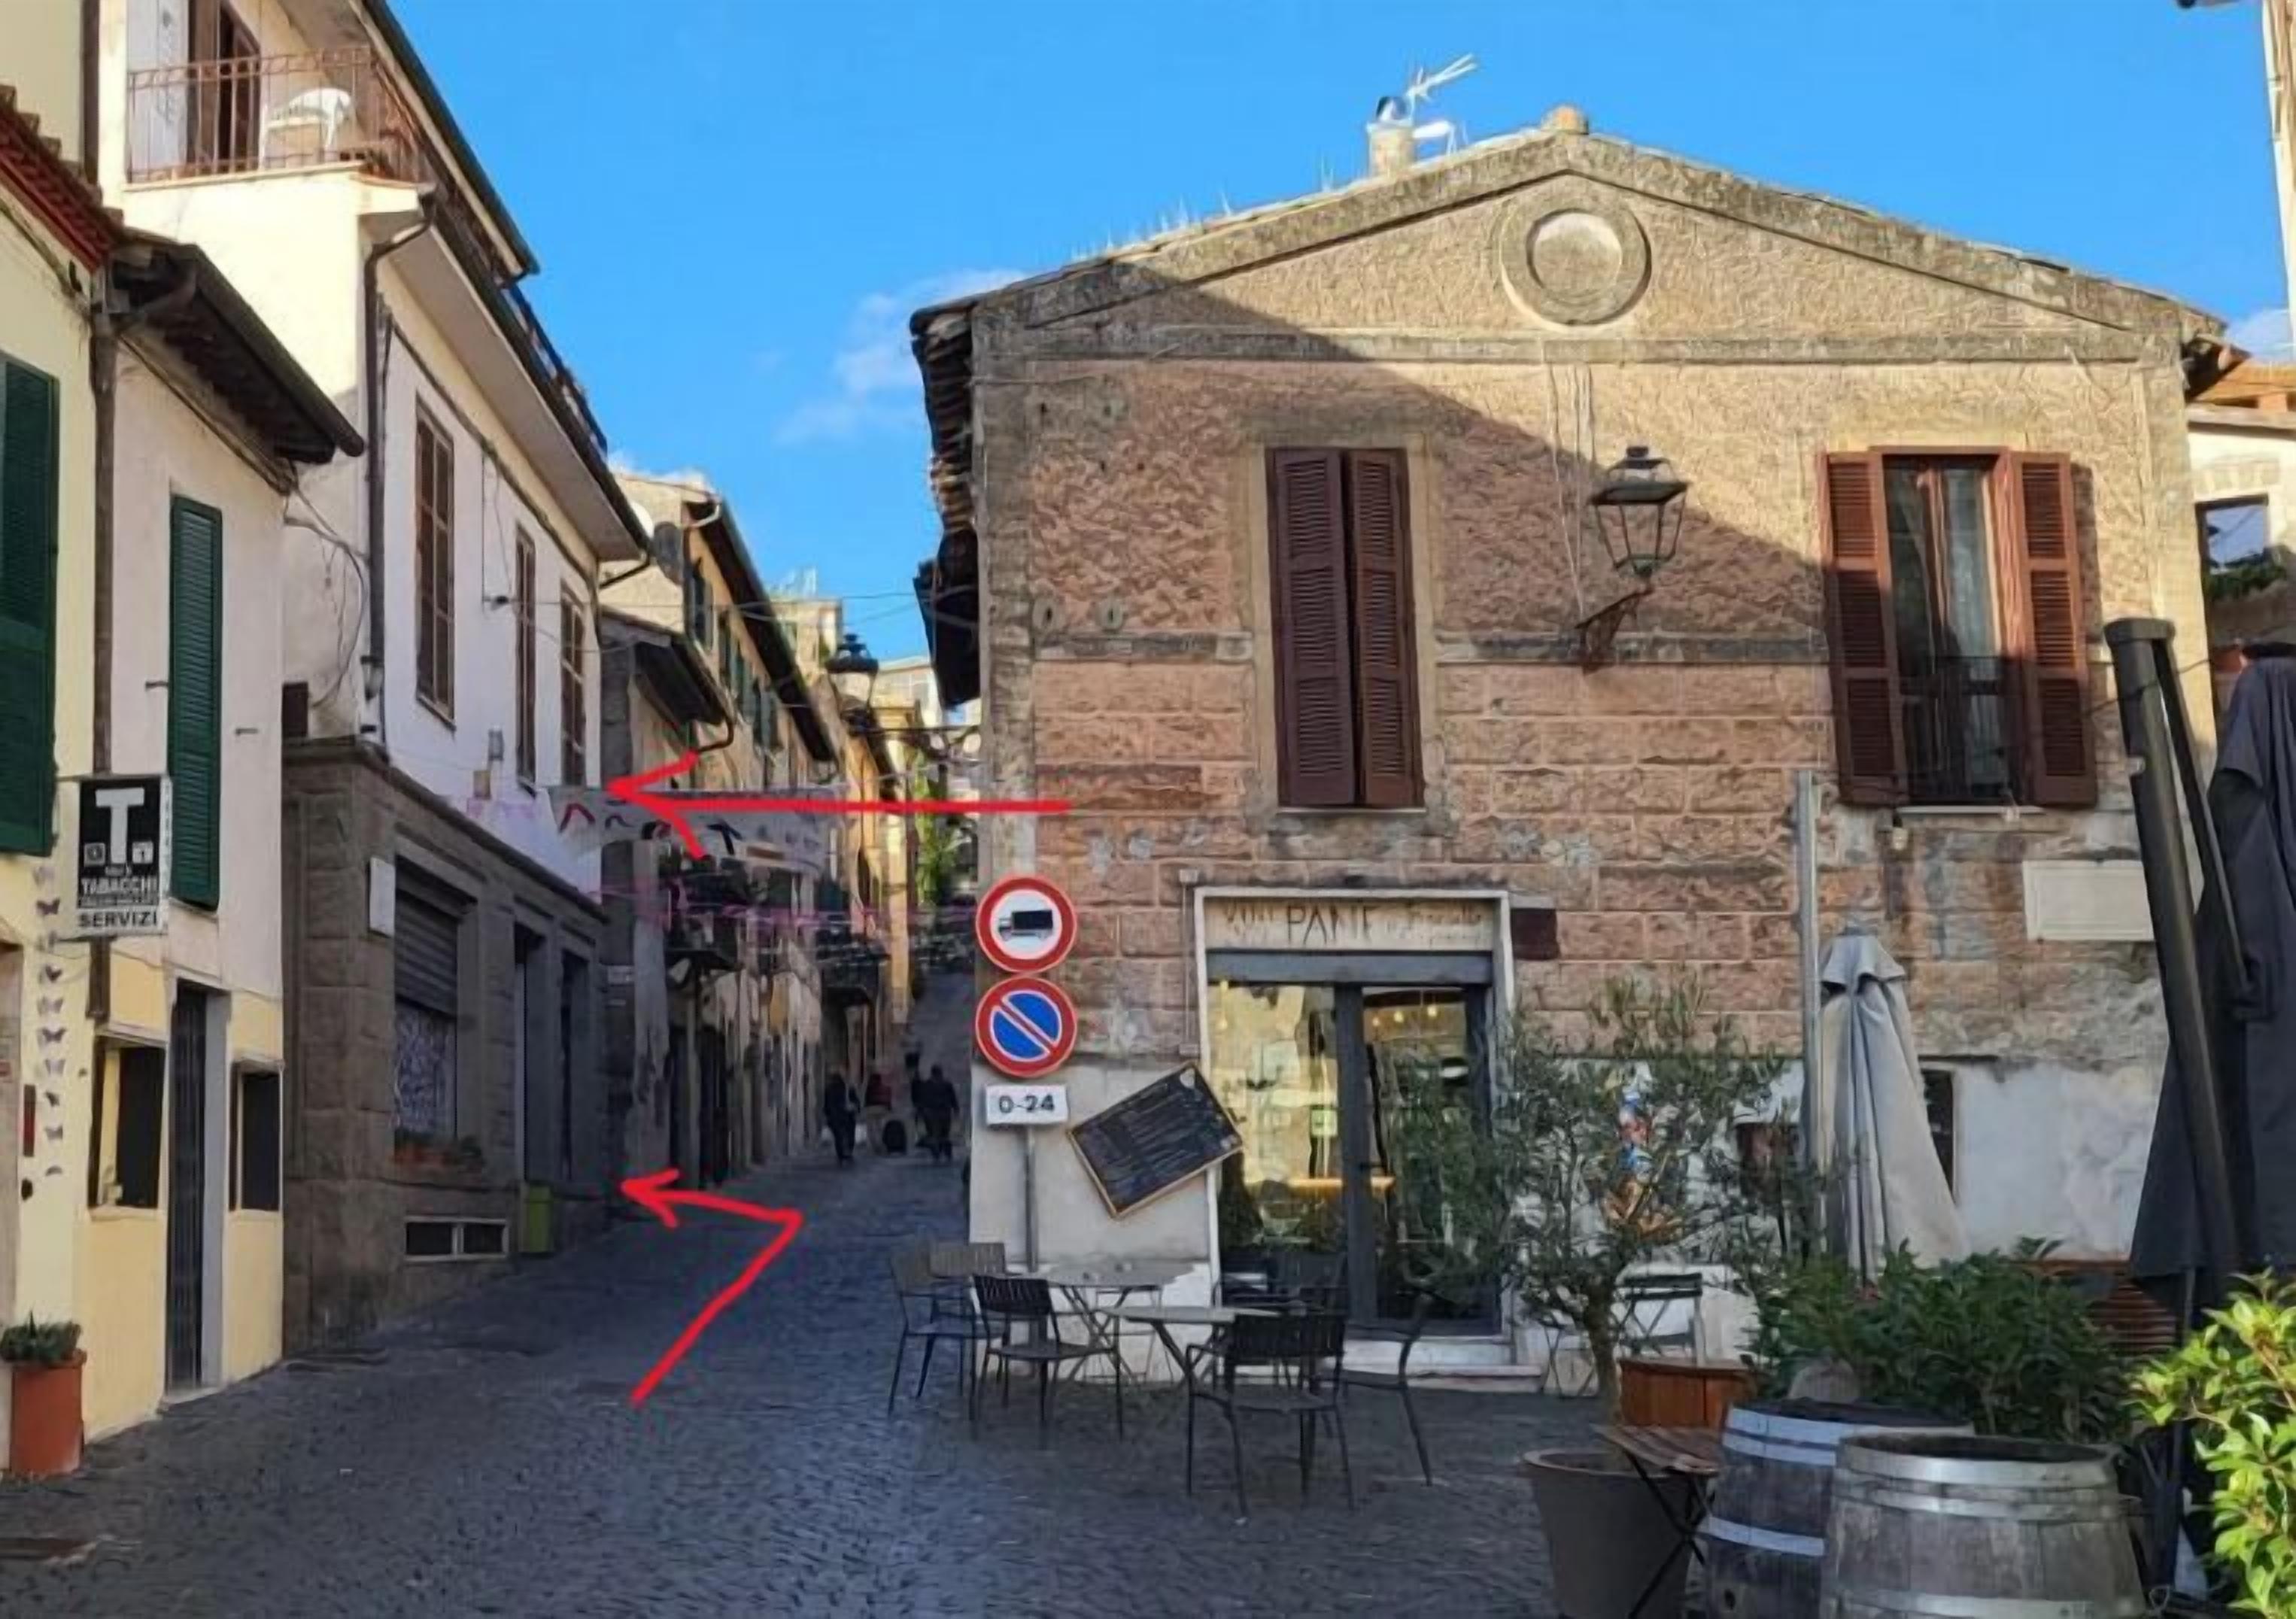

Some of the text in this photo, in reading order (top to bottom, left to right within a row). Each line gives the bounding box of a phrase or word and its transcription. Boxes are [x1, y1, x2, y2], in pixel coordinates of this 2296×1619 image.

[96, 787, 144, 864] T
[78, 912, 157, 927] SERVIZI
[998, 1095, 1055, 1113] 0-24
